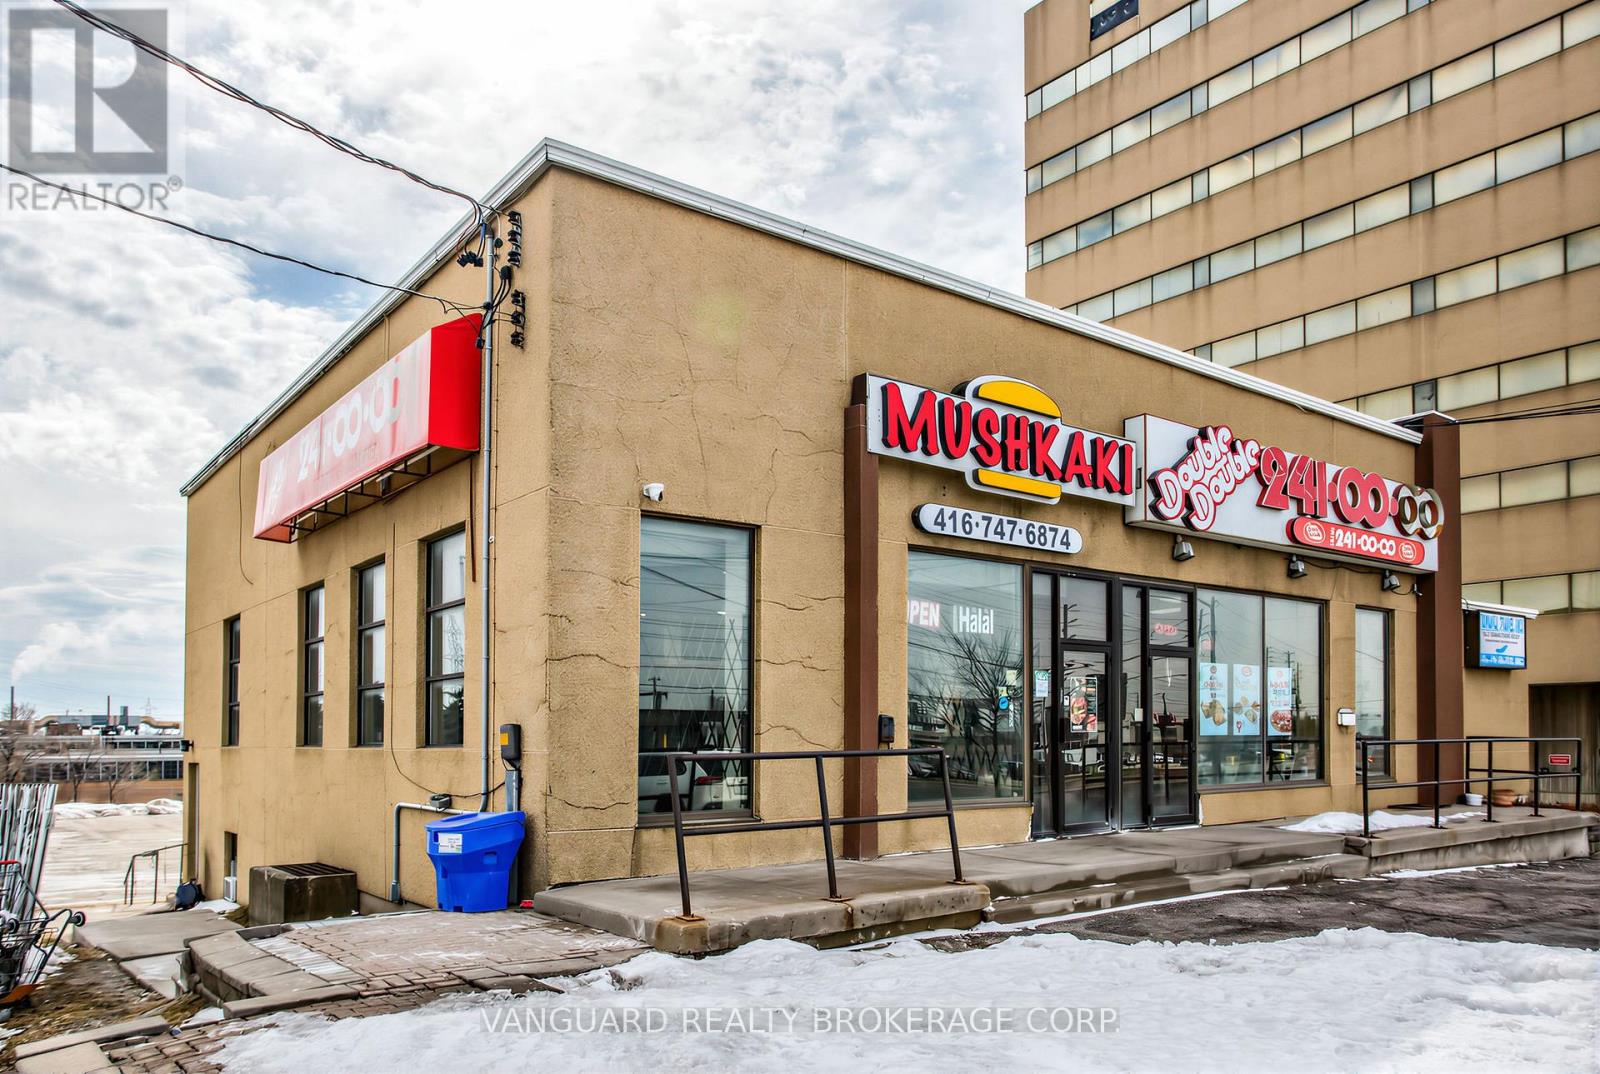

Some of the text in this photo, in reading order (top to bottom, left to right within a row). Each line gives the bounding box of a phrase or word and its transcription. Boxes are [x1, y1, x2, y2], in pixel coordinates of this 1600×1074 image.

[882, 382, 1133, 495] MUSHKAKI
[1152, 425, 1233, 520] Double
[1184, 439, 1261, 531] Double
[908, 600, 940, 628] PEN
[958, 605, 994, 635] Halal
